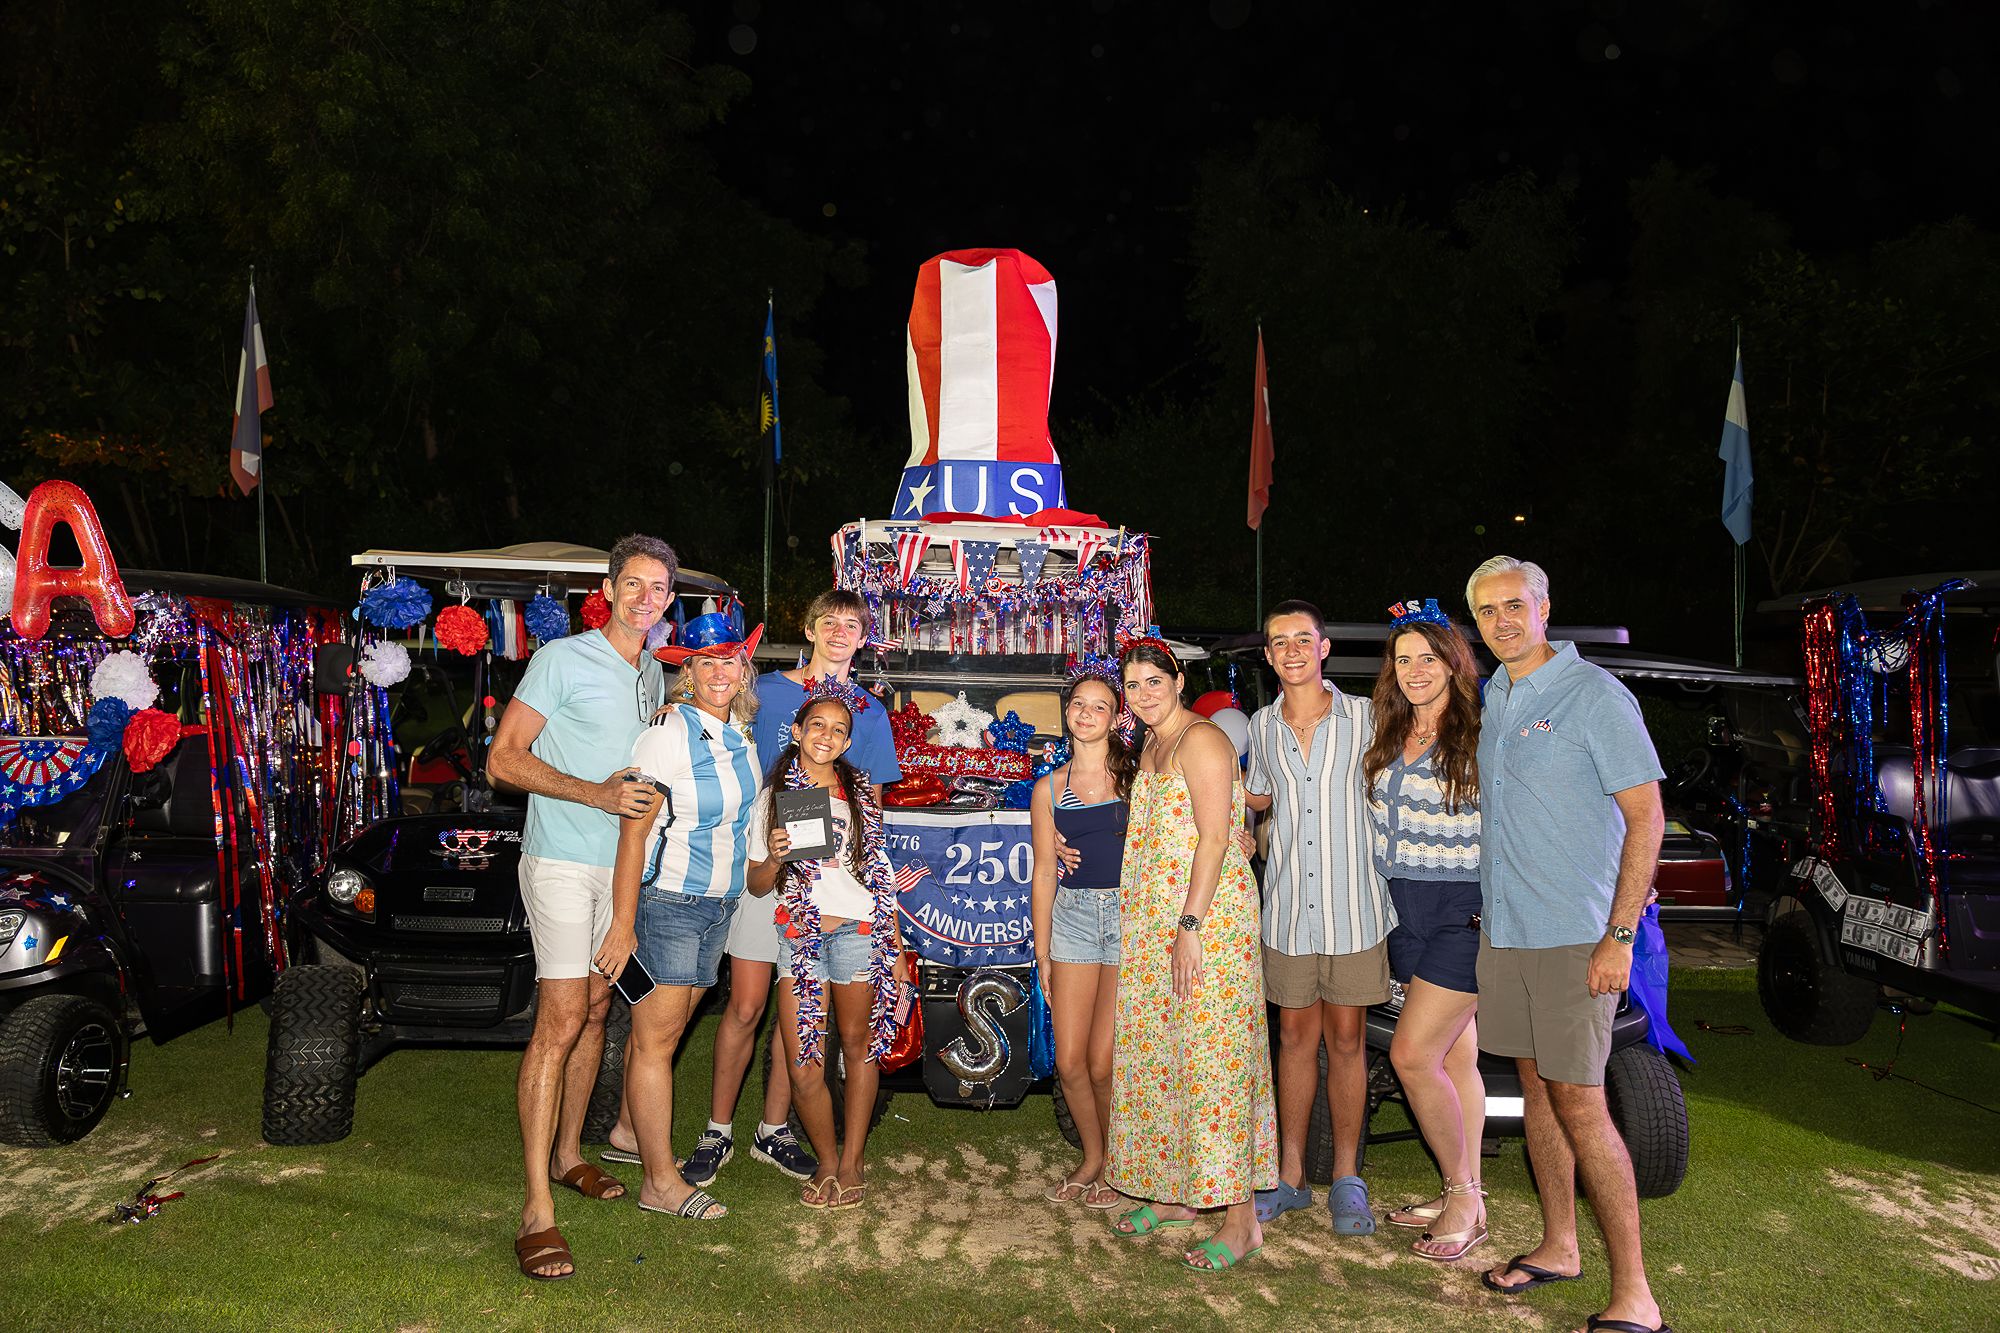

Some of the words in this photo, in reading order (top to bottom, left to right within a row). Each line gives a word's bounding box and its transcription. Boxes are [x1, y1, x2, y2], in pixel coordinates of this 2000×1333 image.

[900, 746, 943, 766] Land
[945, 751, 961, 773] of
[964, 753, 987, 771] the
[991, 755, 1024, 775] Free
[883, 835, 920, 850] 1776
[945, 841, 1034, 885] 250
[1845, 951, 1877, 973] YAMAHA
